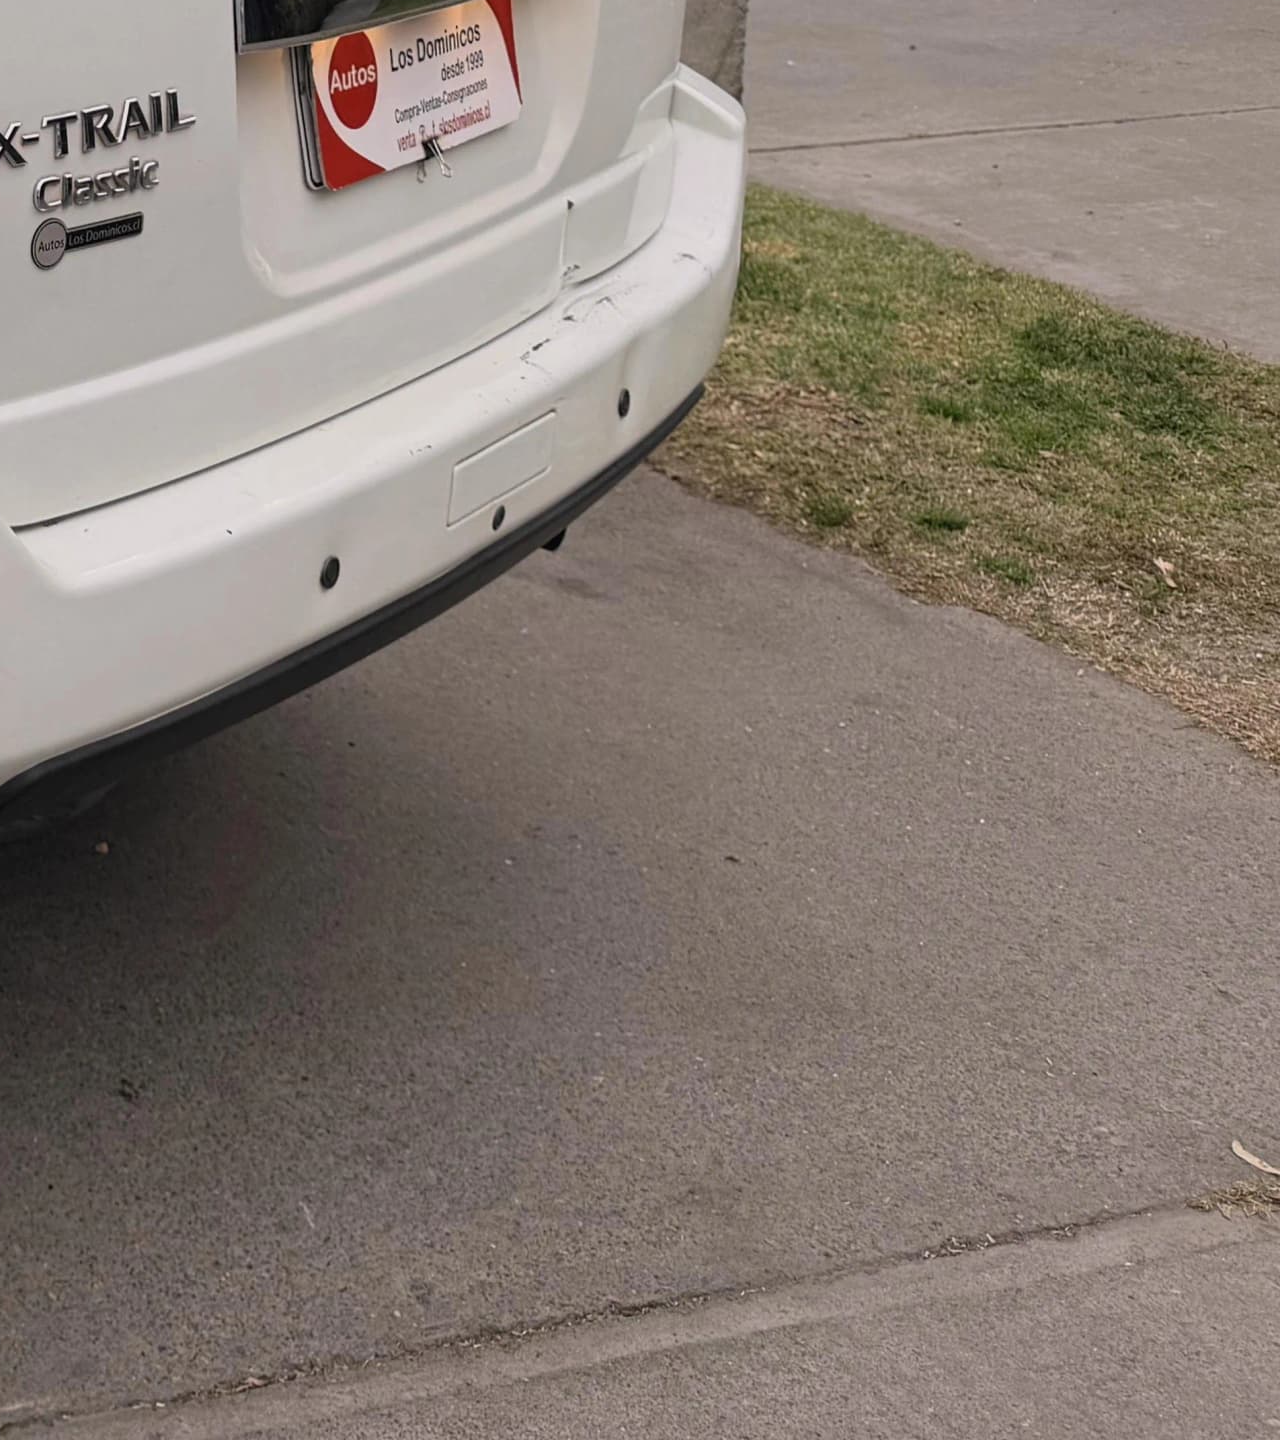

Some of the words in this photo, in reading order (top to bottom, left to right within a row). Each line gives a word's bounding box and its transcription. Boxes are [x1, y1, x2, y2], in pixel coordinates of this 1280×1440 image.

[389, 47, 414, 72] Los
[416, 24, 481, 63] Dominicos
[441, 58, 465, 81] desde
[466, 49, 484, 72] 1999
[330, 63, 377, 94] Autos
[33, 155, 160, 212] Classic
[38, 239, 65, 253] Autos
[68, 234, 85, 247] Los
[86, 218, 140, 242] Dominicos.cl
